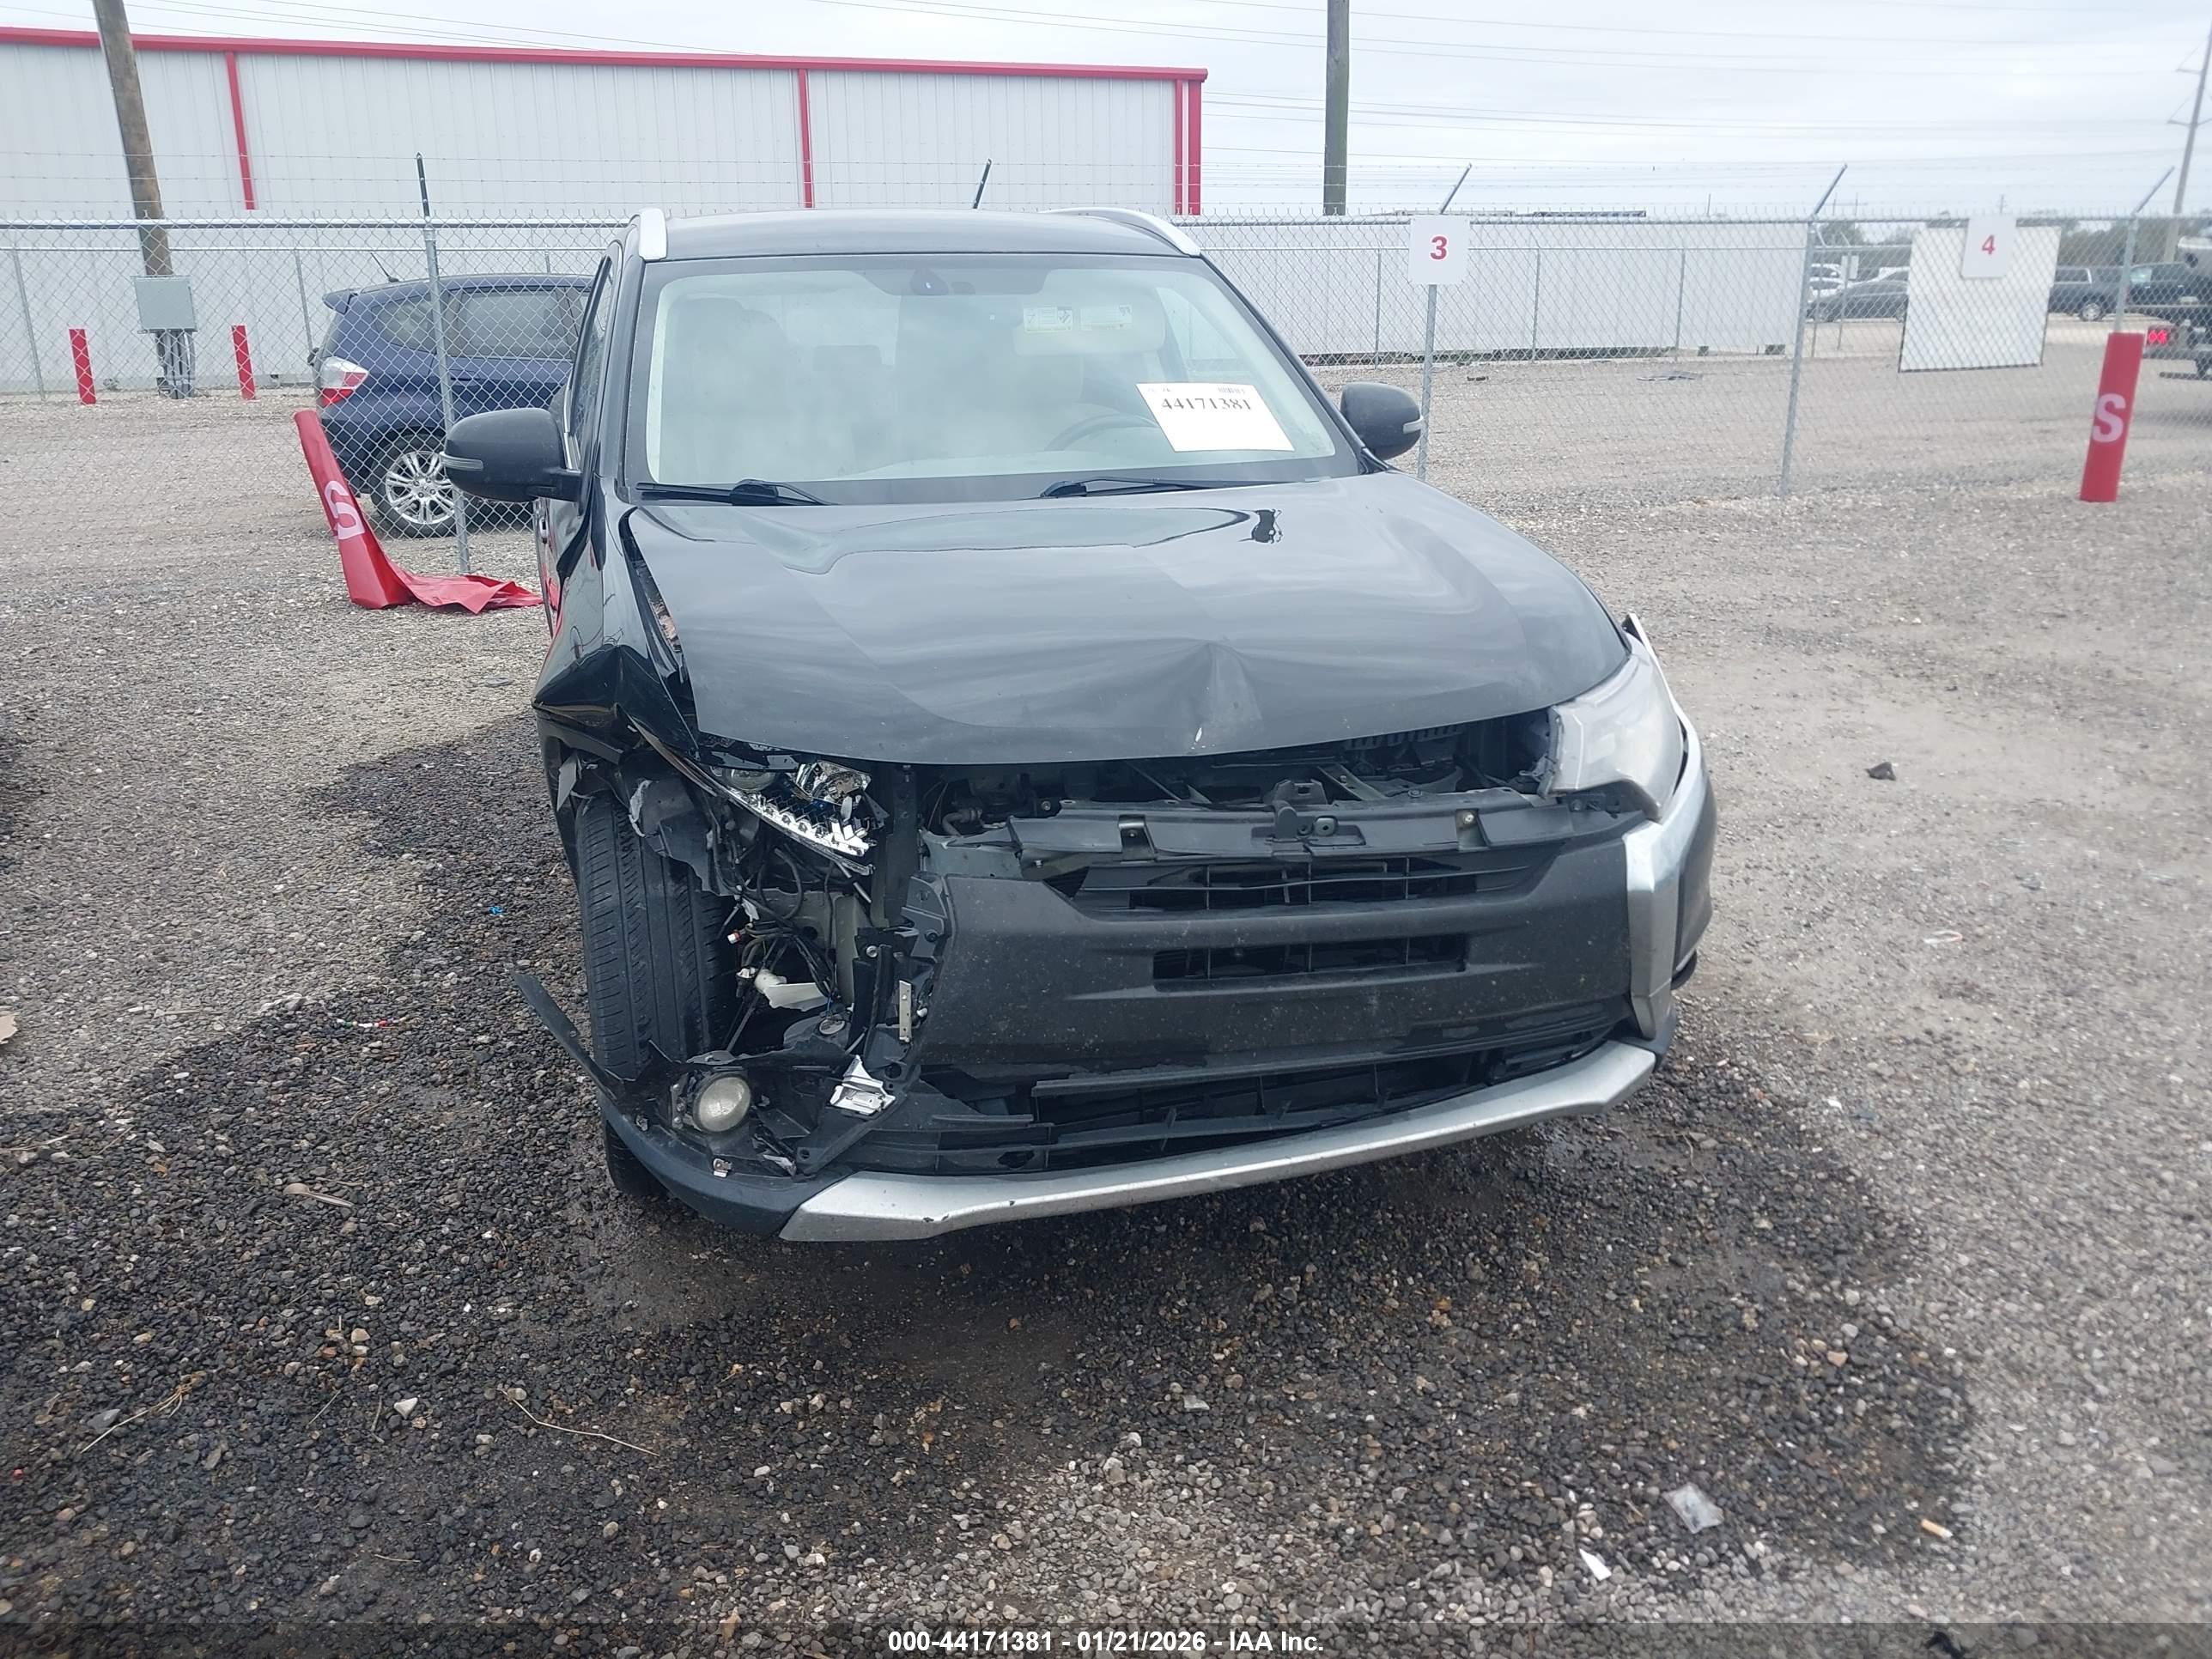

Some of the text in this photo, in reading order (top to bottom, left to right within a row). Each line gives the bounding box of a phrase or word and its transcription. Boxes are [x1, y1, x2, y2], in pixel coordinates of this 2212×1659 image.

[1430, 235, 1448, 260] 3
[1981, 234, 1996, 255] 4
[1161, 398, 1252, 410] 44171381
[2092, 392, 2126, 444] S
[325, 480, 366, 540] S
